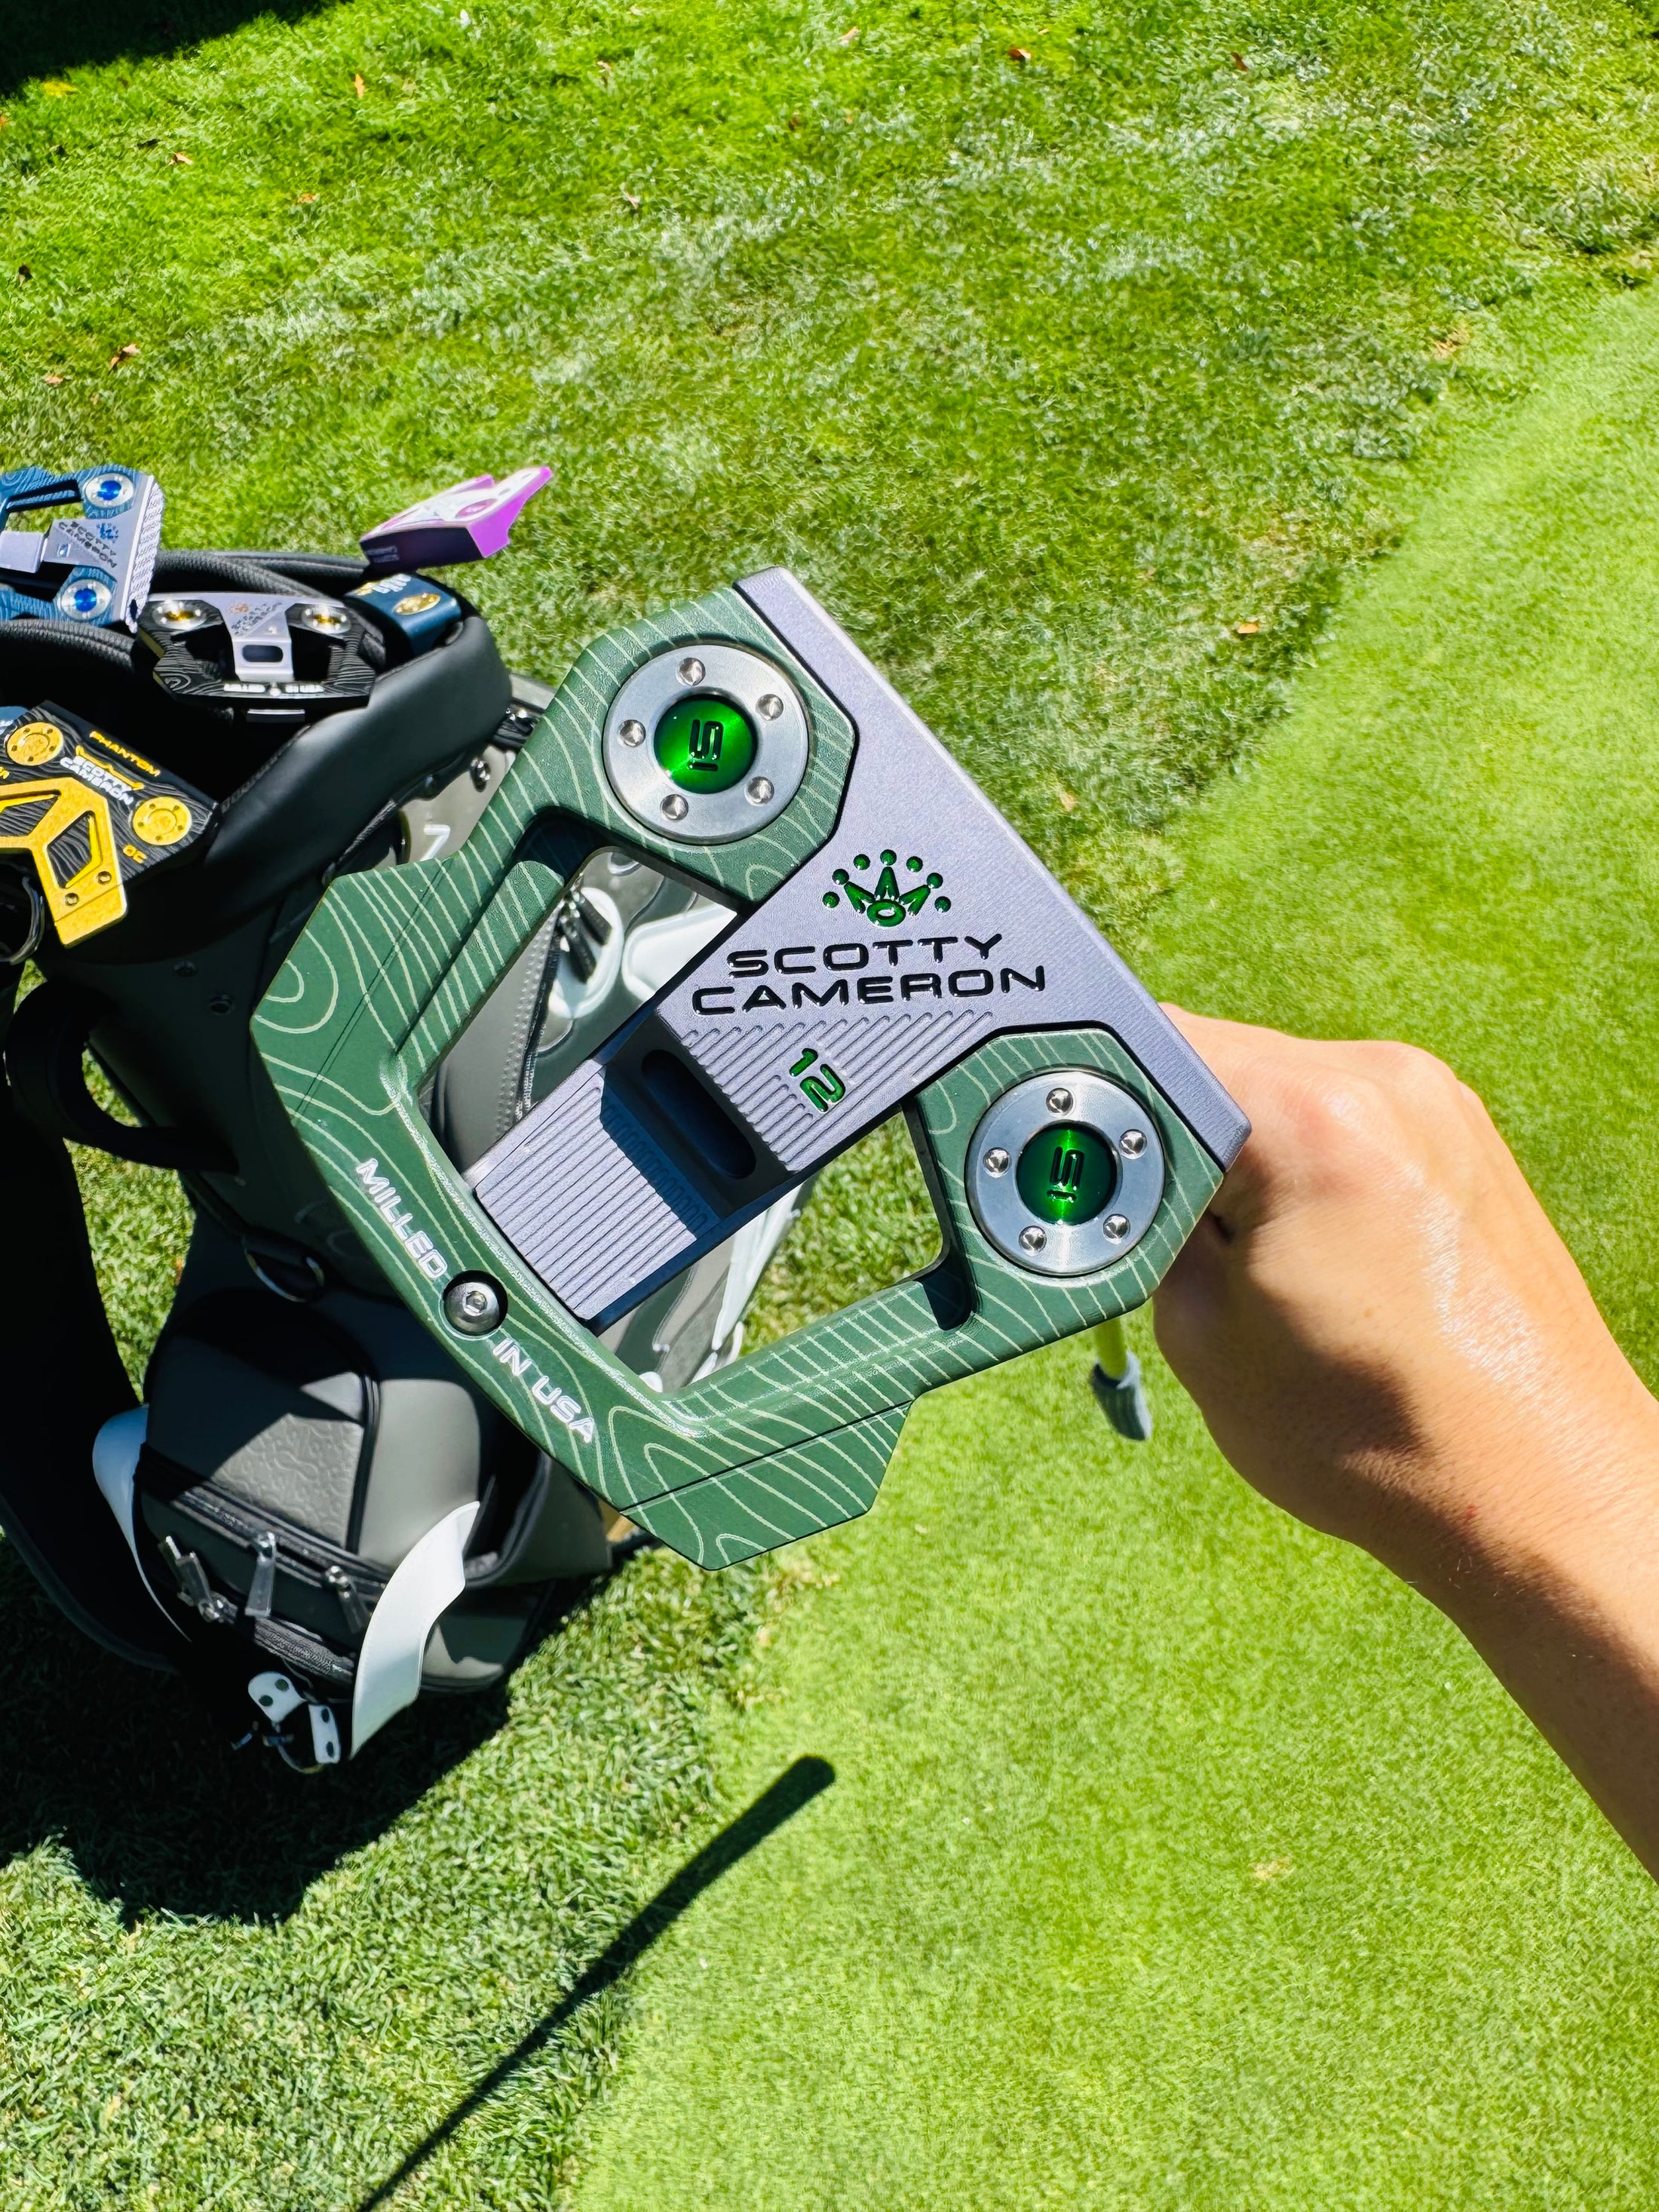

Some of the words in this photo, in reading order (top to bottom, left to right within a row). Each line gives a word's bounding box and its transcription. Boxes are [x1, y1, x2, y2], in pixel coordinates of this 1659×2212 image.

[72, 756, 132, 792] SCOTTY
[89, 731, 161, 777] PHANTOM
[60, 756, 134, 805] CAMERON
[726, 933, 1003, 979] SCOTTY
[692, 965, 1045, 1016] CAMERON
[789, 1048, 846, 1112] 12
[355, 1157, 449, 1280] MILLED
[492, 1338, 532, 1377] IN
[531, 1375, 596, 1444] USA
